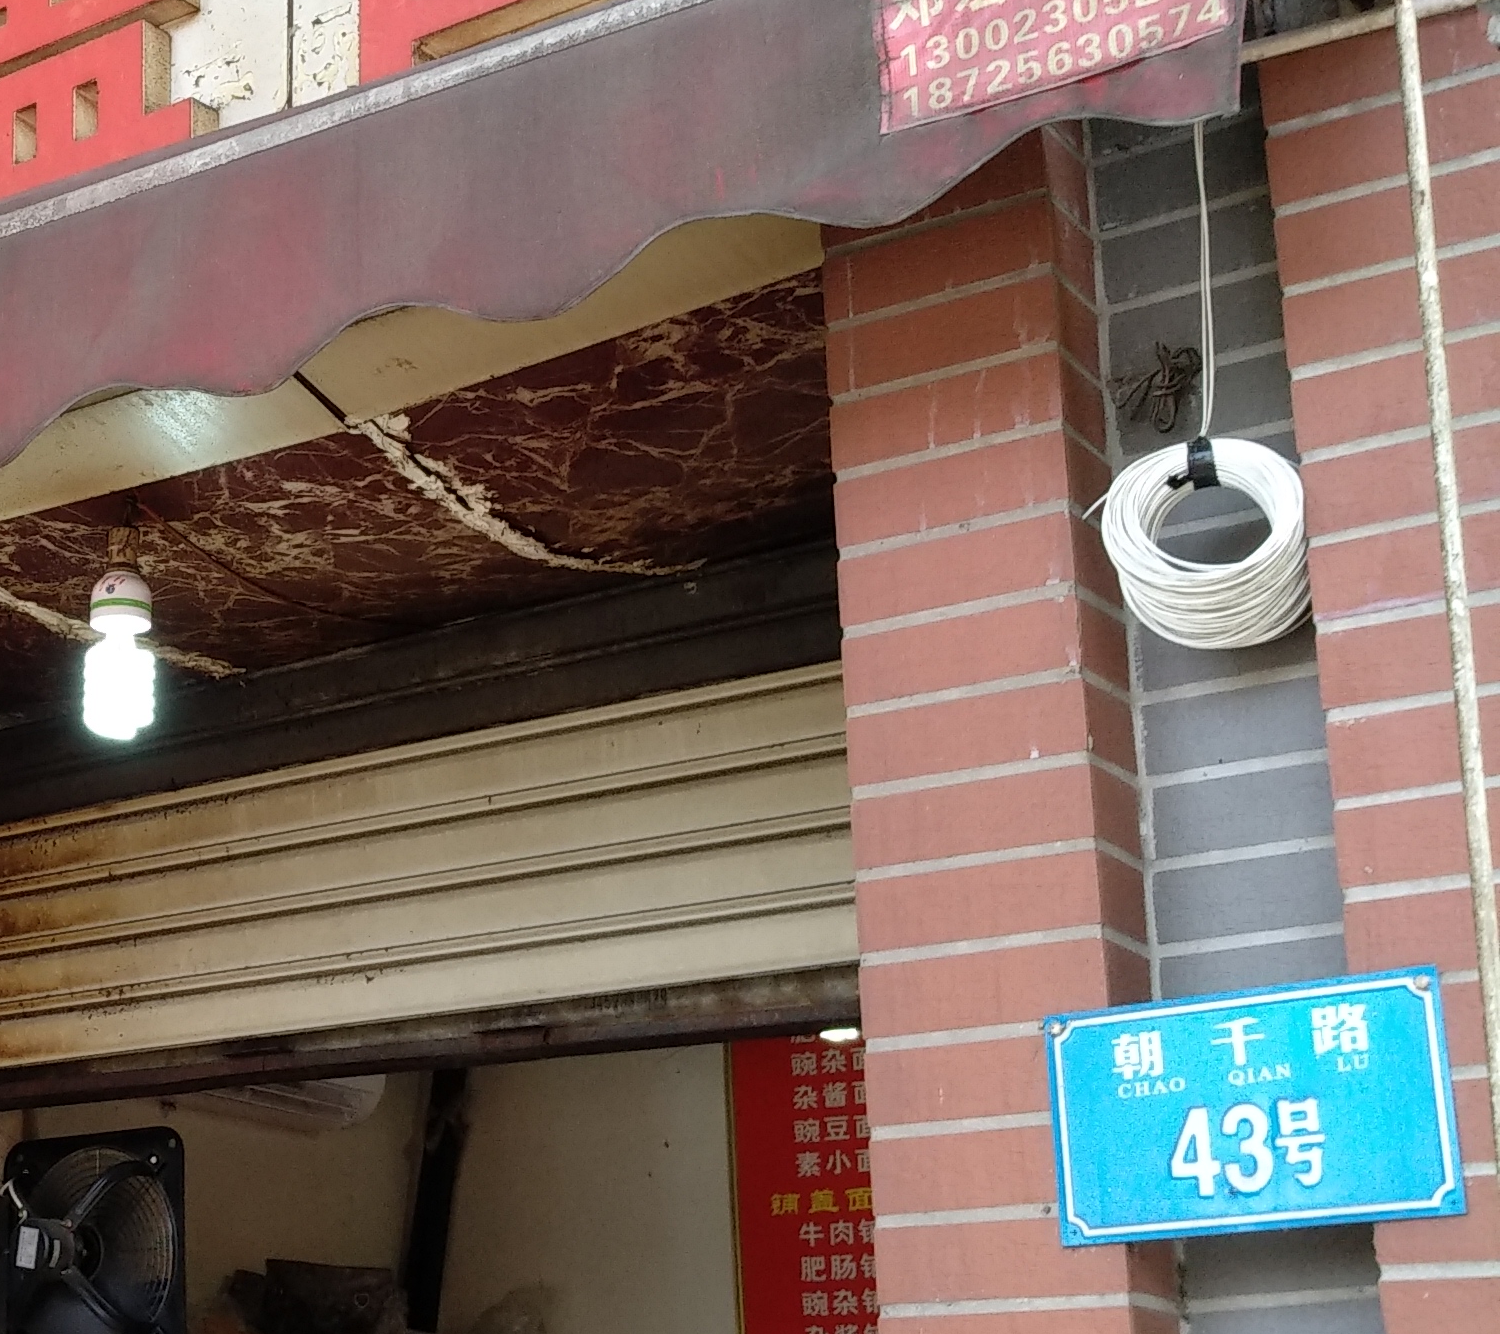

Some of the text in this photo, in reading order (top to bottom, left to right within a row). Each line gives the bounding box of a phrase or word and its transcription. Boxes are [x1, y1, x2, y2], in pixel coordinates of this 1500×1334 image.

[1110, 1002, 1370, 1081] 朝千路
[1117, 1054, 1370, 1100] CHAO QIAN LU
[1171, 1096, 1326, 1197] 43号
